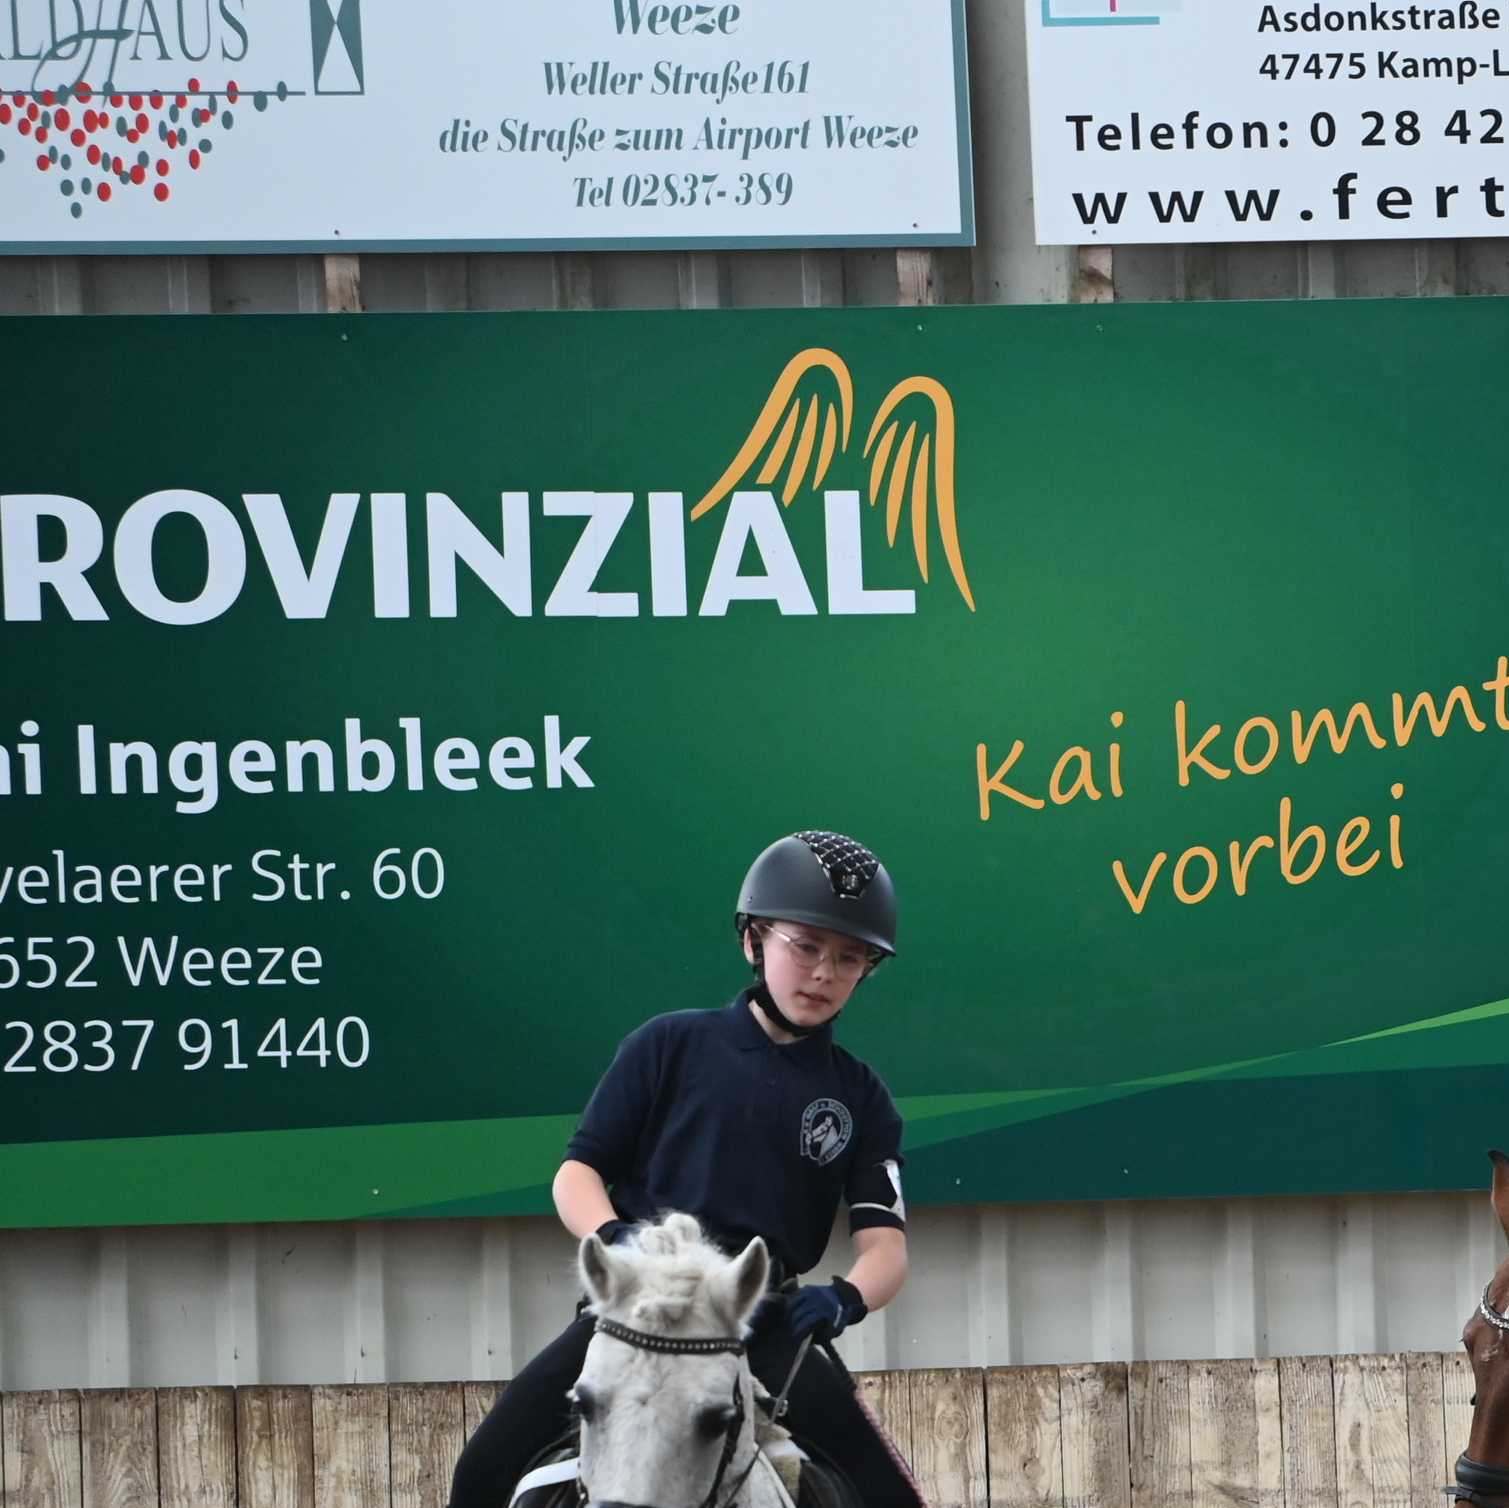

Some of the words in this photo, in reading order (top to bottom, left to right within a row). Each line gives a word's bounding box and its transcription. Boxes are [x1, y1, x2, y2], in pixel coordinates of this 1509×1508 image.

[614, 0, 740, 35] Weeze
[1258, 1, 1500, 32] Asdonkstraße
[544, 61, 643, 95] Weller
[1259, 53, 1366, 80] 47475
[440, 119, 488, 152] die
[497, 118, 605, 162] Straße
[615, 128, 683, 151] zum
[693, 117, 810, 160] Airport
[824, 115, 918, 148] Weeze
[1066, 111, 1288, 151] Telefon:
[1311, 112, 1335, 147] 0
[1362, 111, 1420, 146] 28
[1445, 109, 1504, 144] 42
[574, 177, 613, 207] Tel
[735, 173, 792, 205] 389
[0, 489, 916, 625] ROVINZIAL
[78, 715, 595, 813] Ingenbleek
[977, 712, 1123, 820] Kai
[1111, 782, 1404, 914] vorbei
[252, 849, 350, 901] Str.
[373, 848, 444, 899] 60
[117, 936, 322, 986] Weeze
[4, 1020, 154, 1072] 2837
[179, 1016, 369, 1070] 91440
